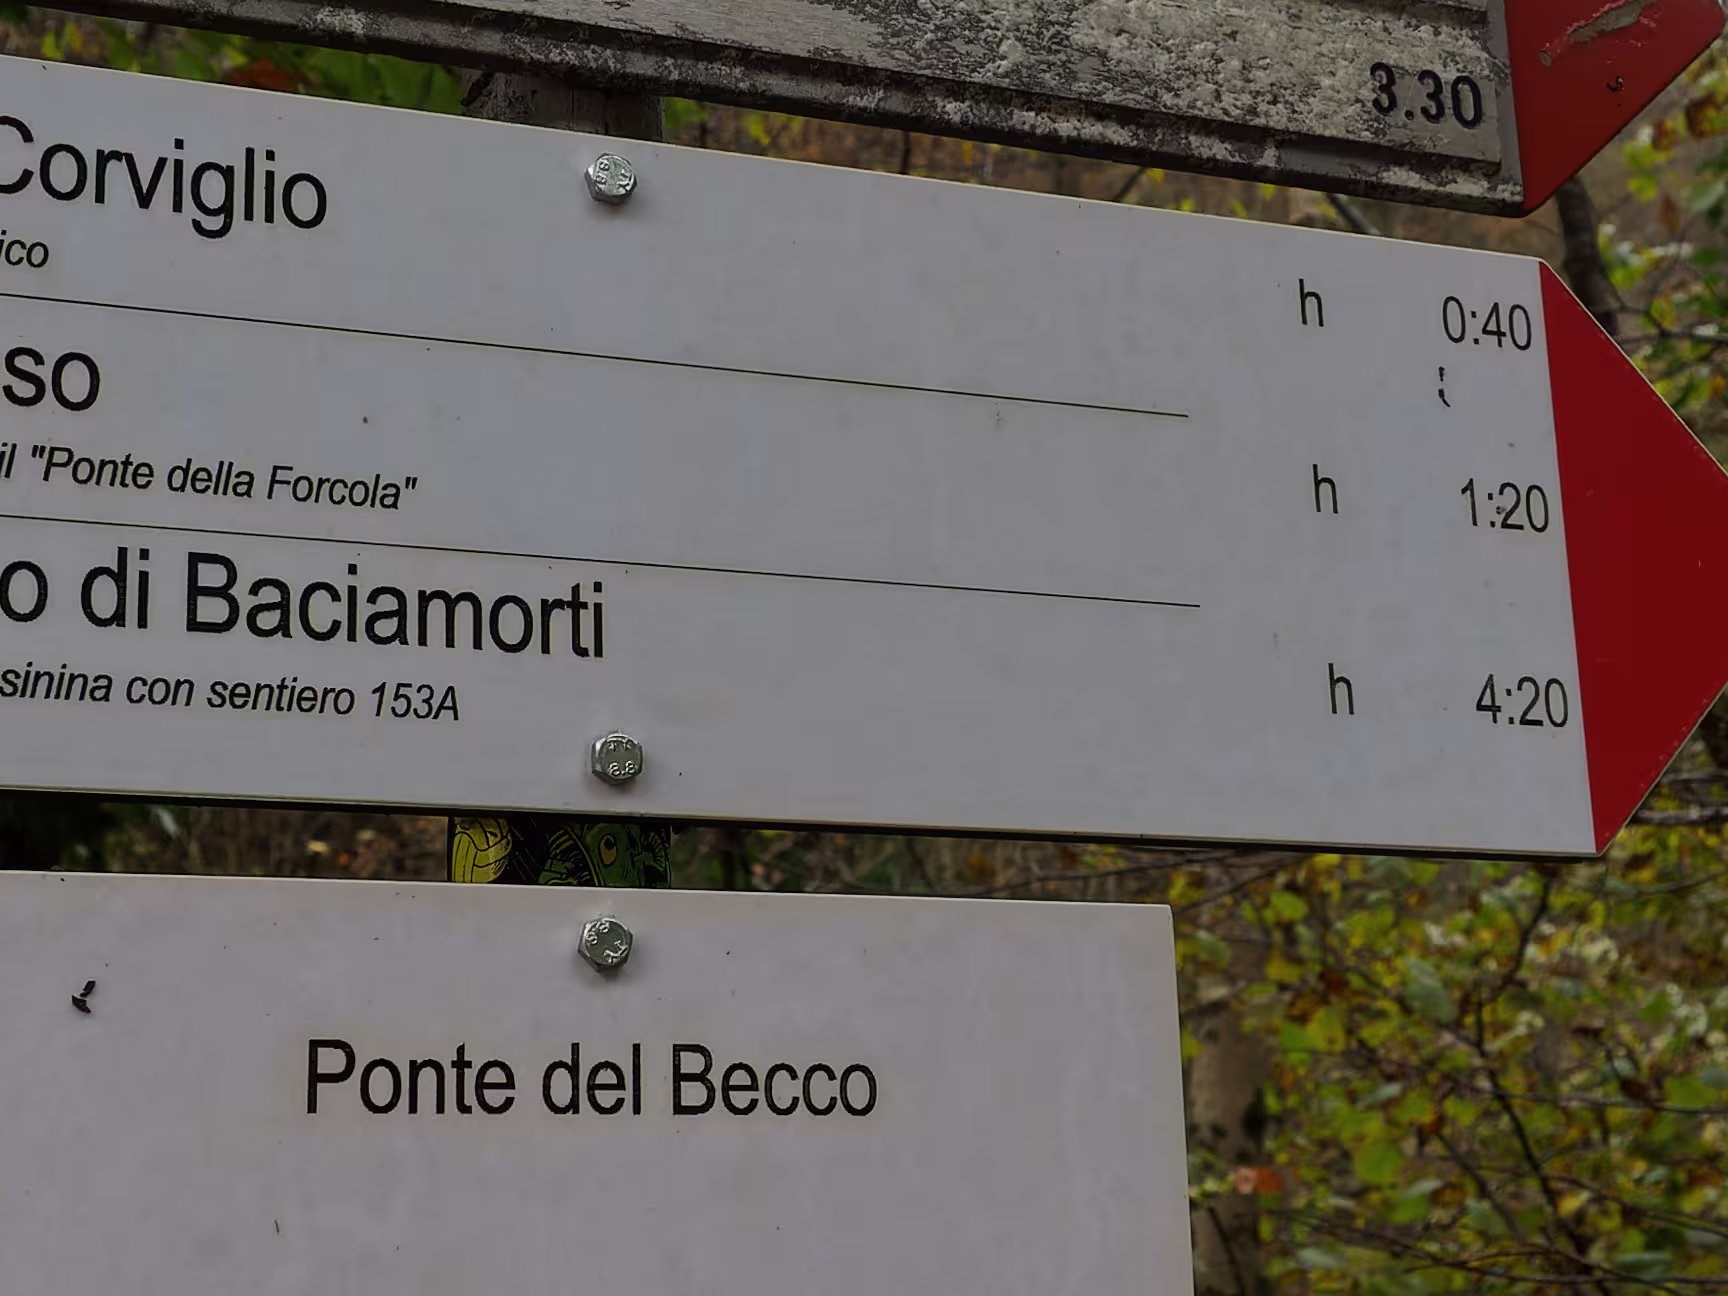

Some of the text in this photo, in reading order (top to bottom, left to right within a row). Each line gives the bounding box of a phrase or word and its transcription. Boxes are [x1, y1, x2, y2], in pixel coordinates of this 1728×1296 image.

[1370, 61, 1483, 129] 3.30
[1298, 278, 1532, 351] h 0:40
[30, 444, 154, 490] "Ponte
[166, 457, 255, 498] della
[266, 465, 417, 510] Forcola"
[1312, 463, 1550, 533] h 1:20
[80, 547, 150, 630] di
[185, 550, 604, 659] Baciamorti
[126, 677, 195, 707] con
[205, 677, 355, 715] sentiero
[372, 682, 461, 721] 153A
[1328, 663, 1568, 728] h 4:20
[306, 1037, 878, 1118] Ponte del Becco
